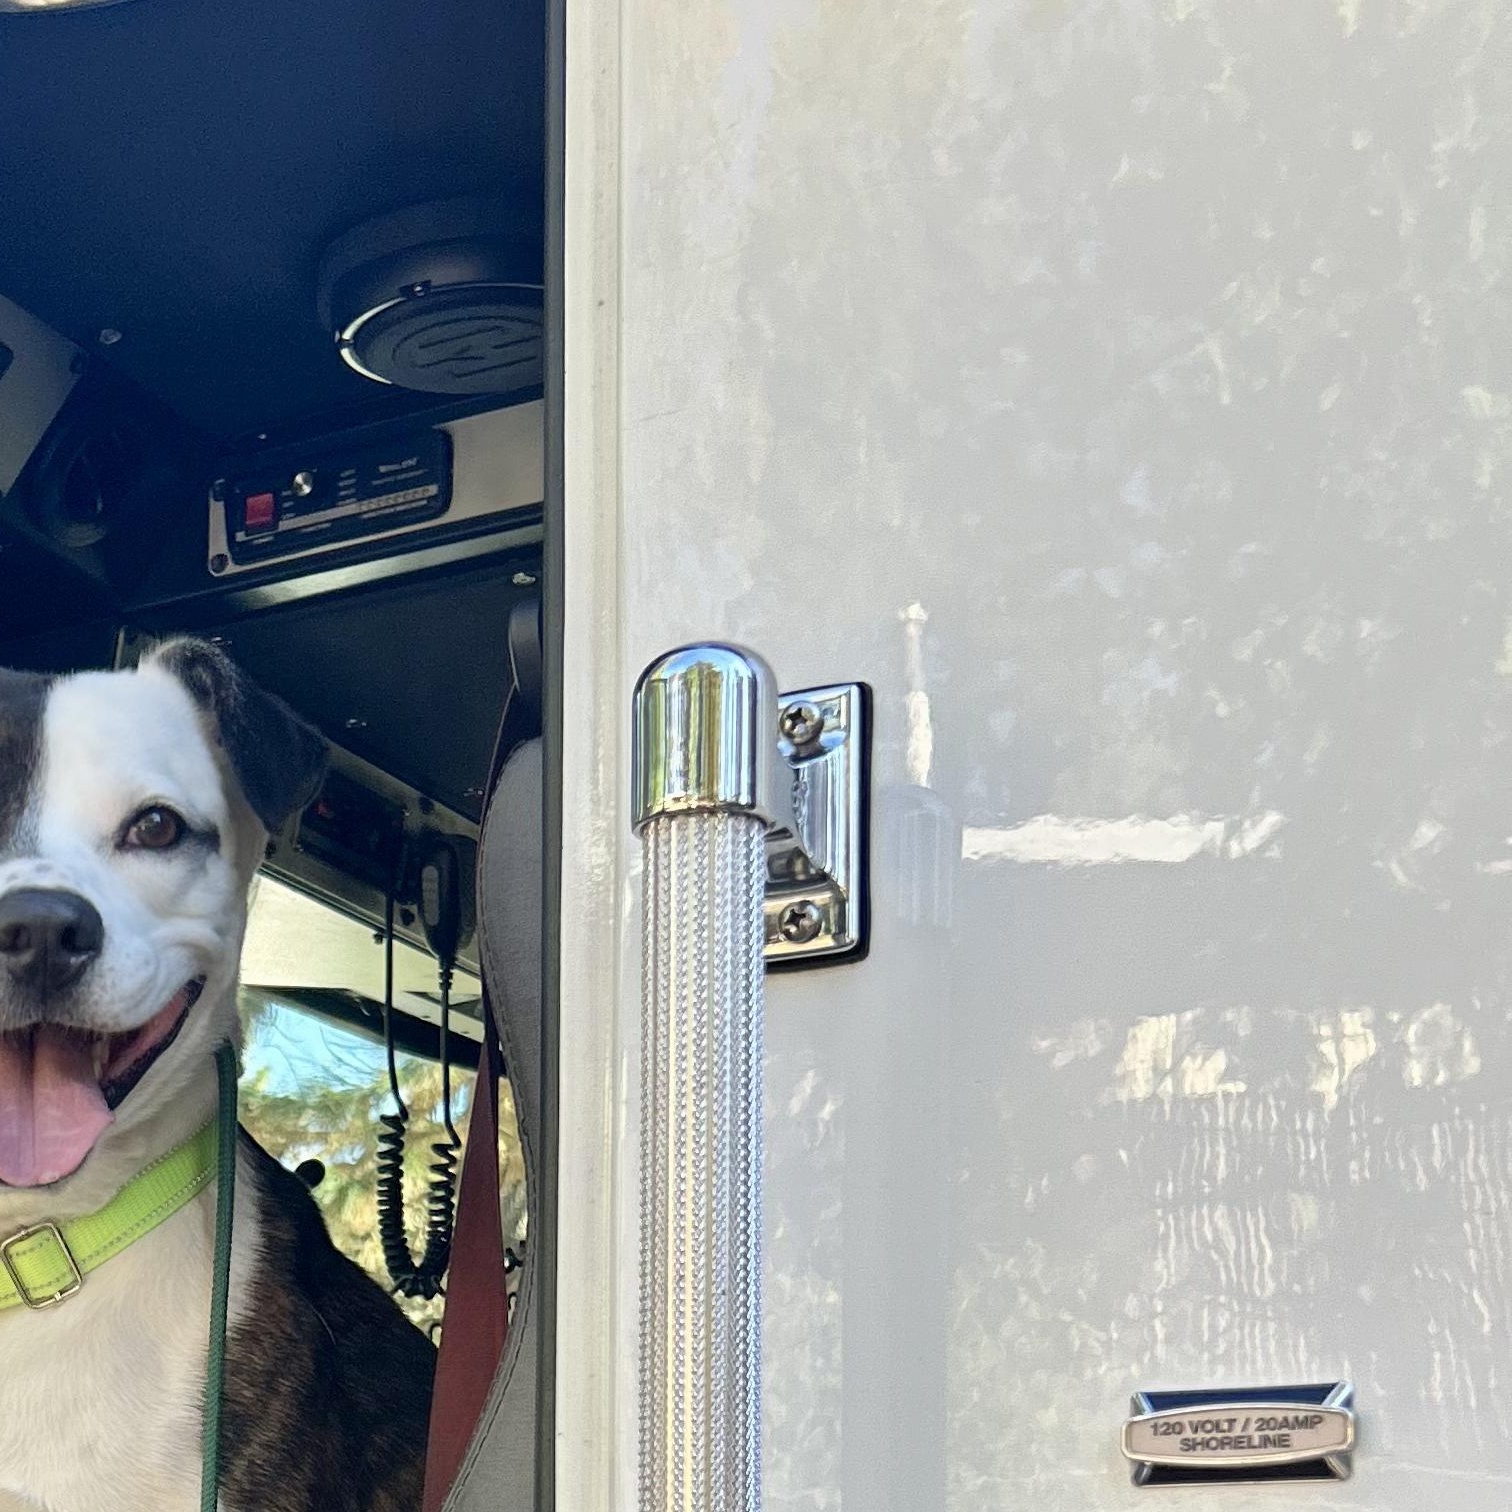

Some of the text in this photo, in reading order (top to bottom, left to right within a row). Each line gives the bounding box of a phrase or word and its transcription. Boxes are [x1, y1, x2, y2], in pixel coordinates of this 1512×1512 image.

[1151, 1415, 1323, 1436] 120 VOLT / 20AMP
[1179, 1434, 1290, 1452] SHORELINE
